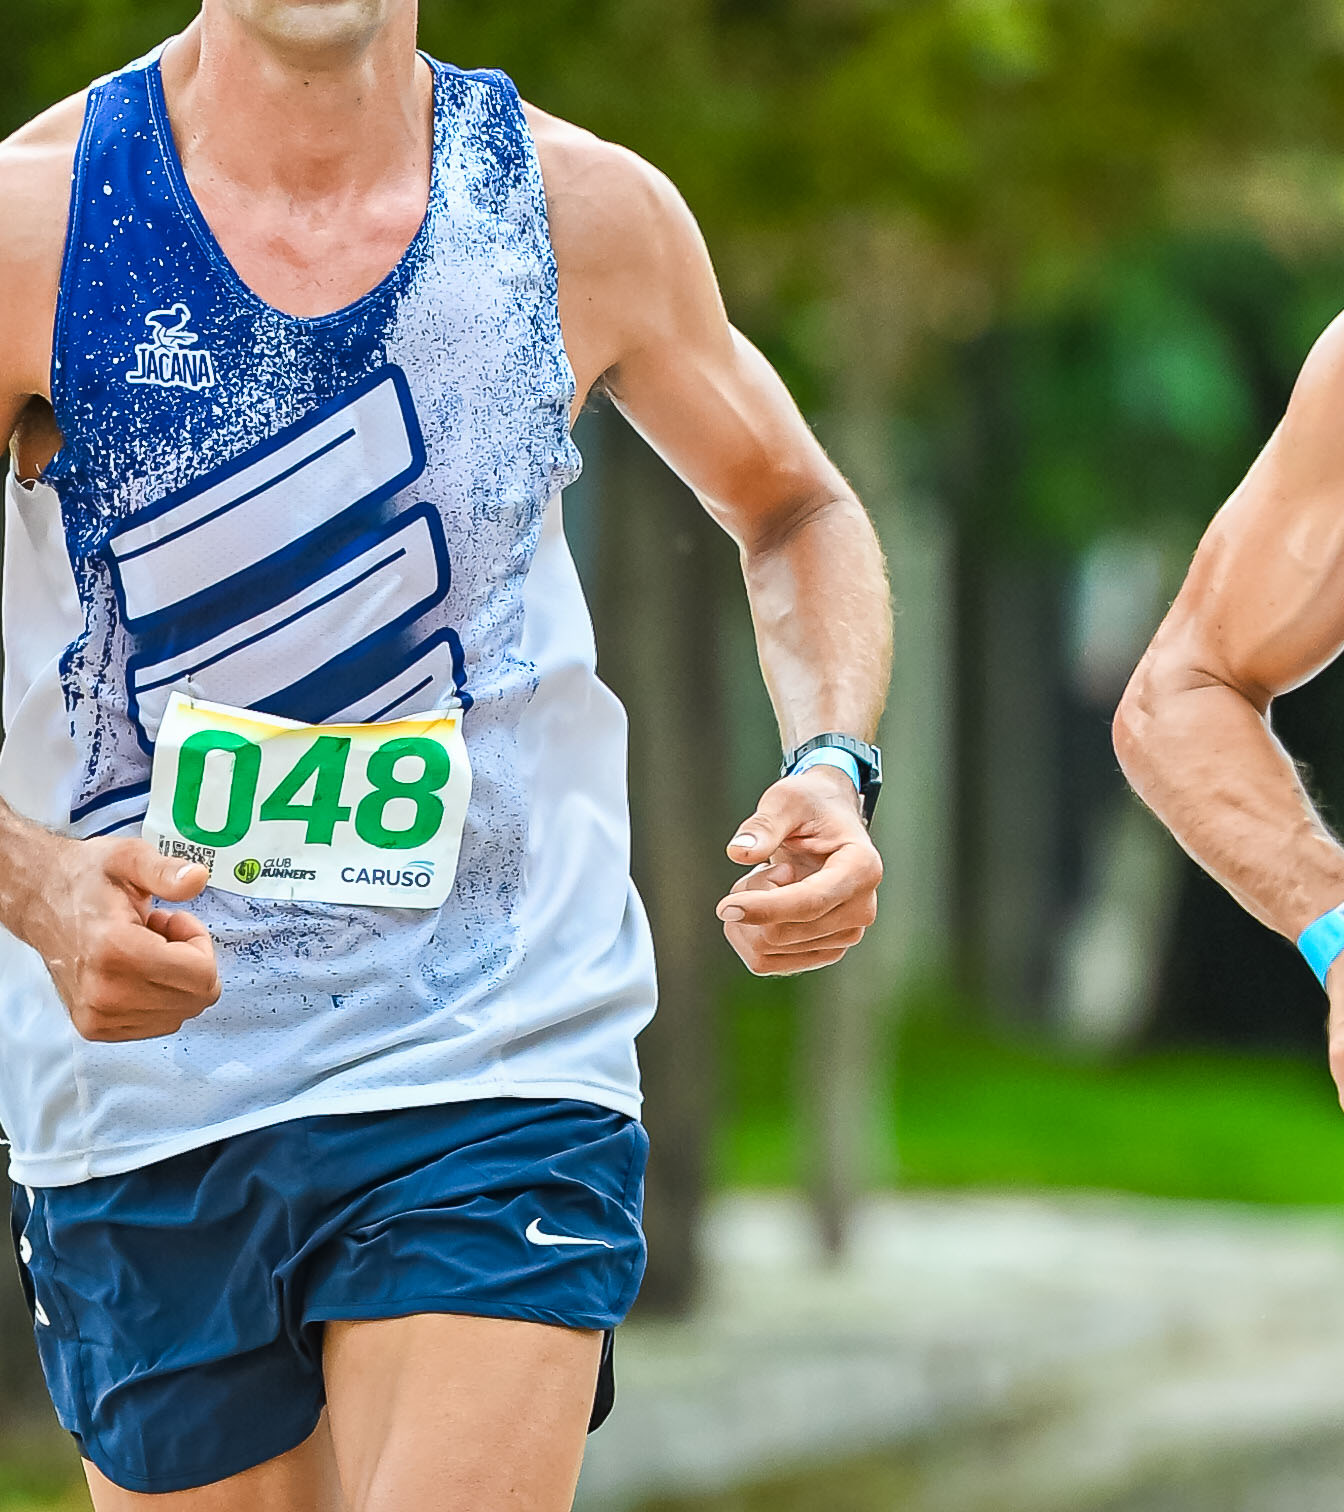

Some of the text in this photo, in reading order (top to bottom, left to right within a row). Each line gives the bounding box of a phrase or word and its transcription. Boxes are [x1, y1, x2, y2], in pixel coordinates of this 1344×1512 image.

[127, 345, 214, 389] JACANA
[172, 729, 451, 850] 048
[263, 857, 292, 869] CLUB
[340, 867, 432, 888] CARUSO
